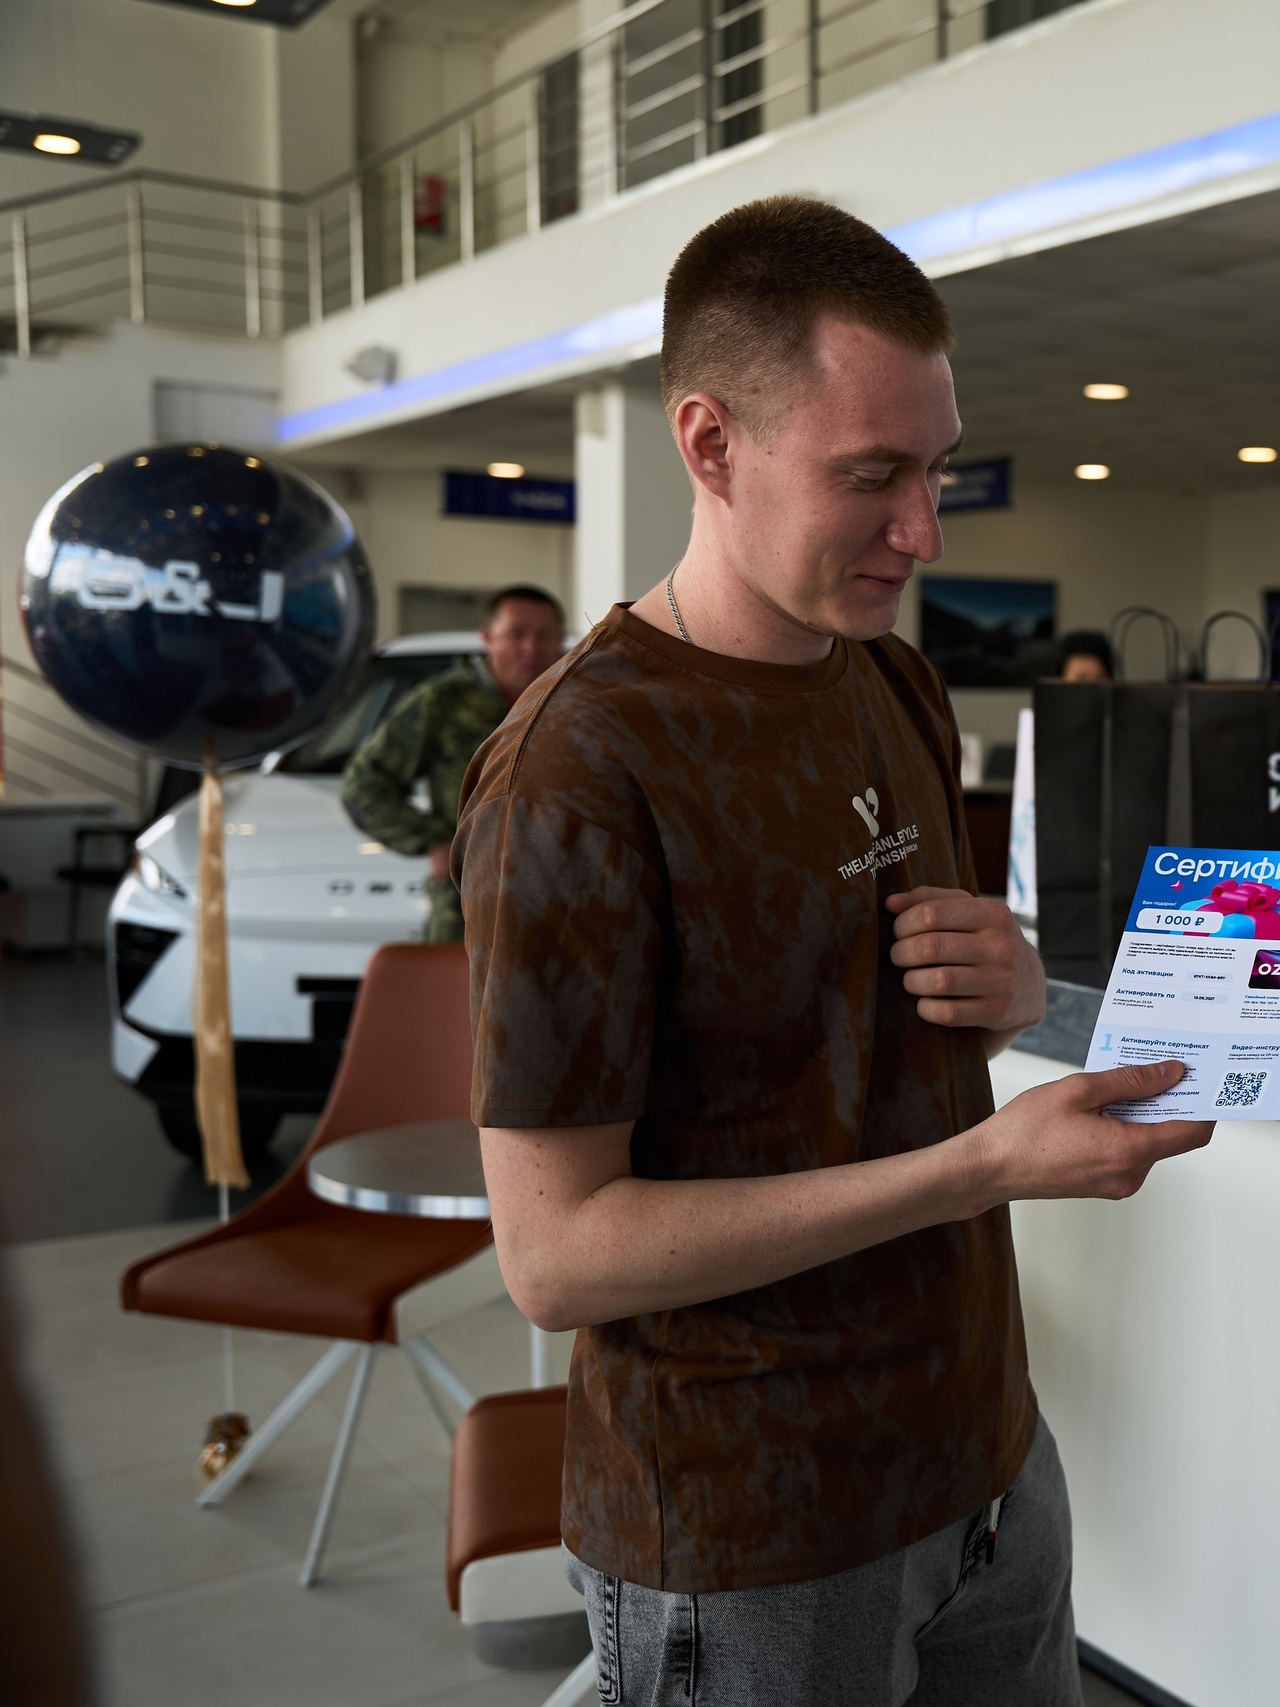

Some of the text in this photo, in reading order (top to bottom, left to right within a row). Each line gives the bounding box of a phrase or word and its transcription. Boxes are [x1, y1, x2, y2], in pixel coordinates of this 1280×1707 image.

[1156, 914, 1161, 924] 1
[1164, 915, 1191, 926] 000
[1136, 970, 1174, 978] активации
[1116, 989, 1165, 998] Активировать
[1100, 1033, 1113, 1051] 1
[1120, 1036, 1166, 1046] Активируйте
